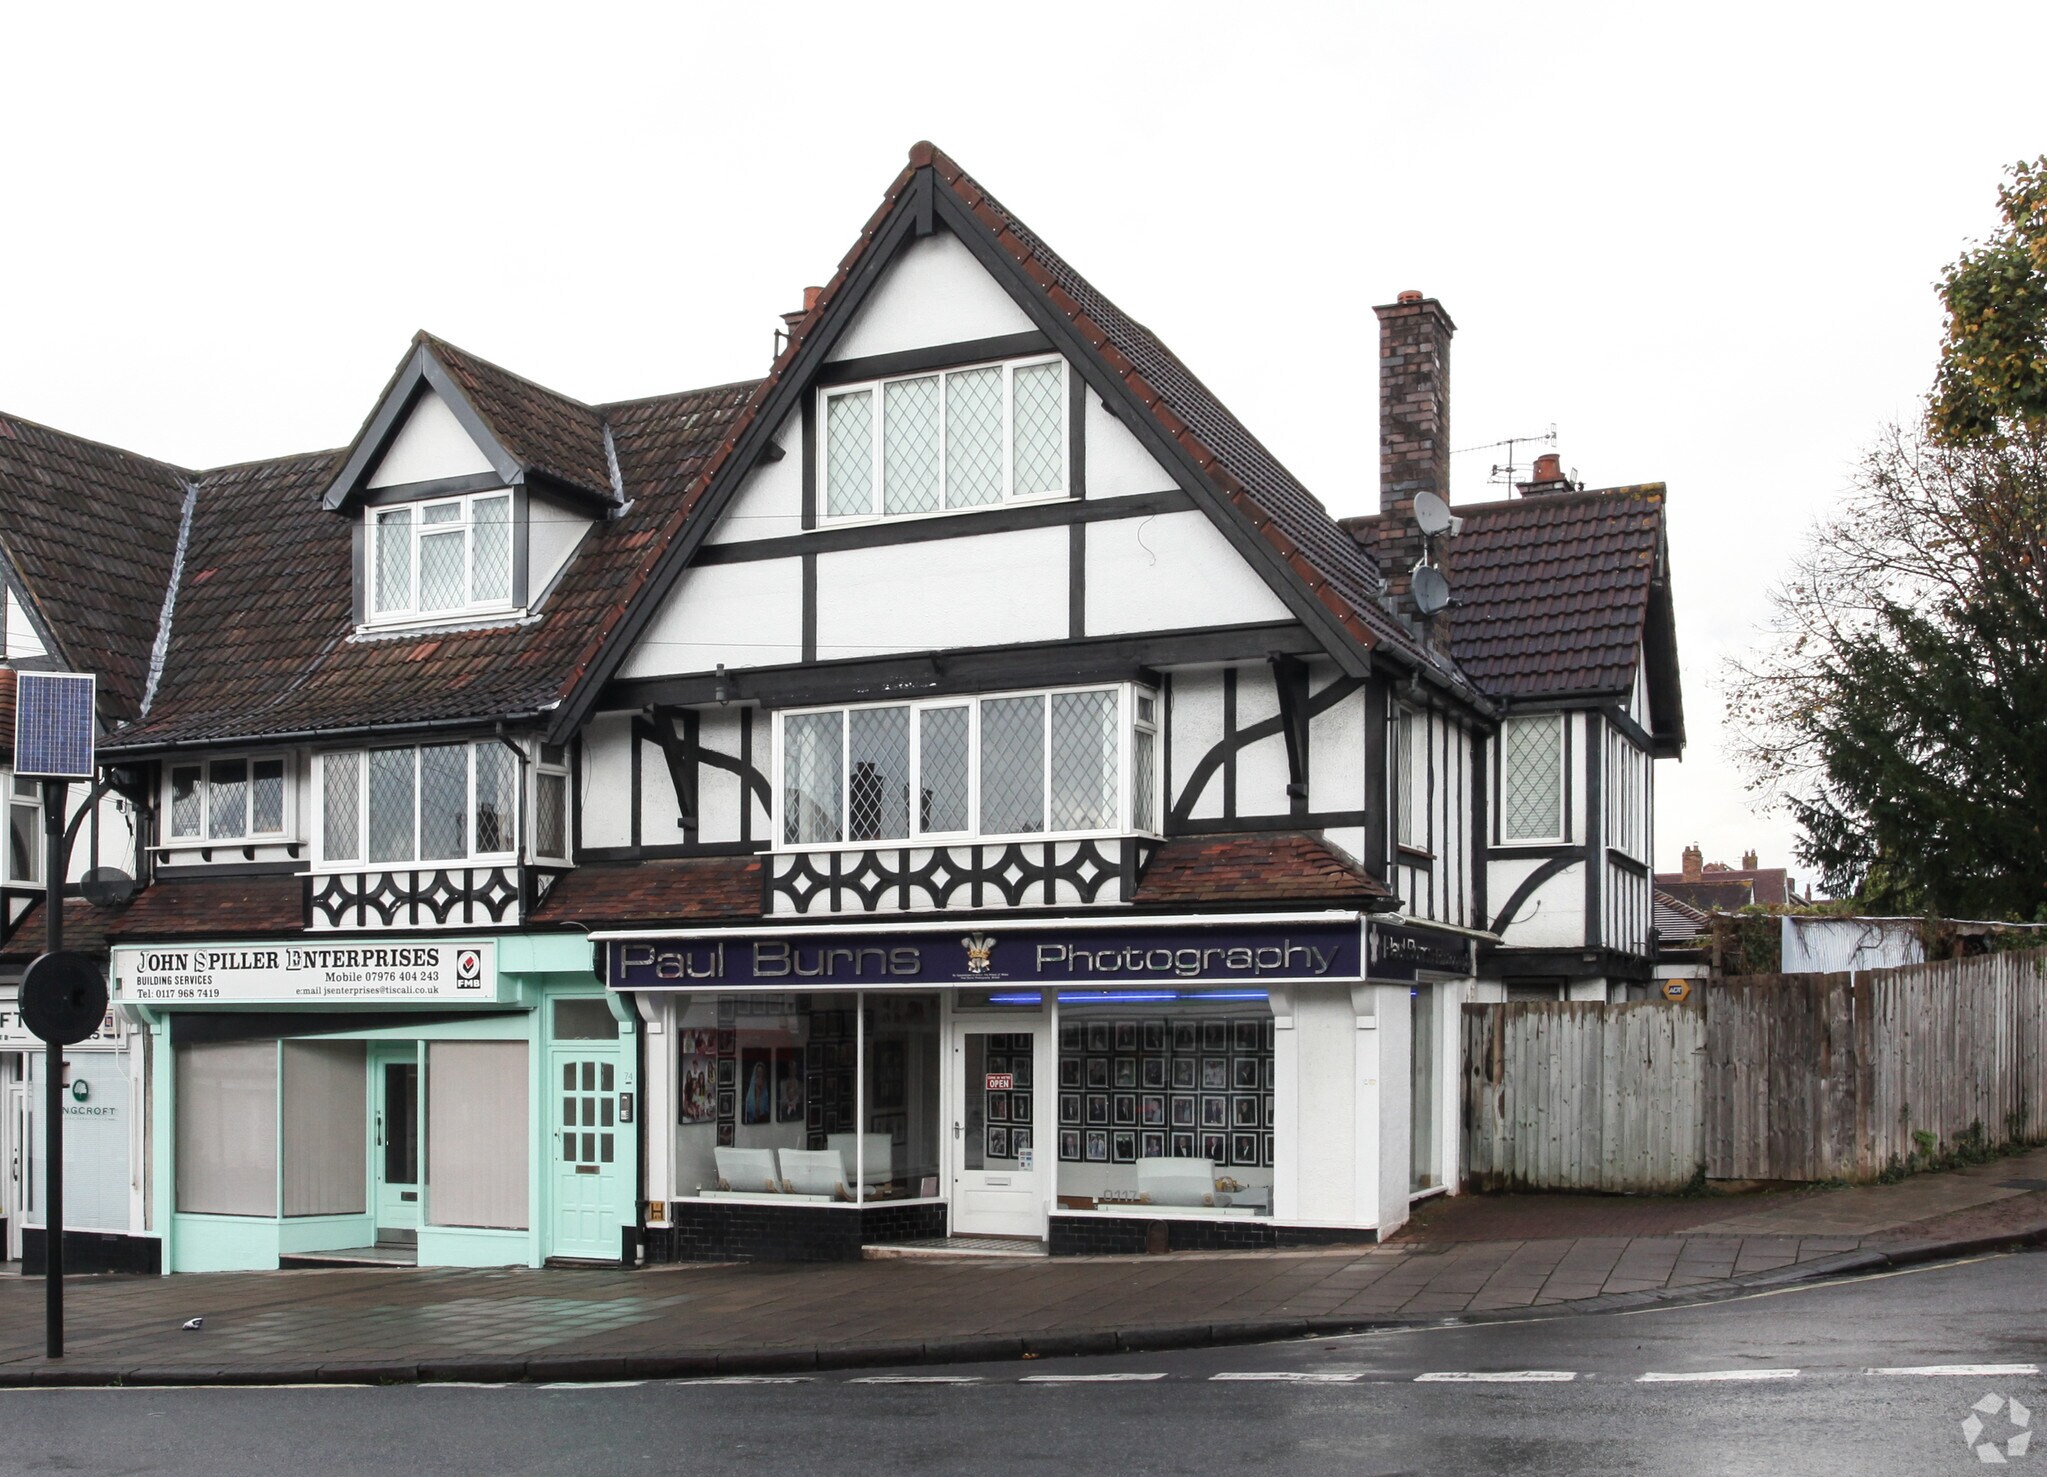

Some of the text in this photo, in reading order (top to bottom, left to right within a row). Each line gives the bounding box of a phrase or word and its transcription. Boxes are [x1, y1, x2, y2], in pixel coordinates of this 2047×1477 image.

[137, 948, 439, 973] JOHN SPILLER ENTERPRISES
[620, 942, 723, 979] Paul
[753, 941, 920, 976] Burns
[1036, 939, 1339, 976] Photography
[137, 975, 212, 985] BUILDING SERVICES
[325, 971, 439, 982] Mobile 07976 404 243
[457, 979, 480, 988] FMB
[137, 989, 219, 998] Tel: 0117 968 7419
[323, 986, 439, 996] jsenterprises@tiscali.co.uk
[990, 1080, 1009, 1088] OPEN
[62, 1106, 115, 1115] NGCROFT
